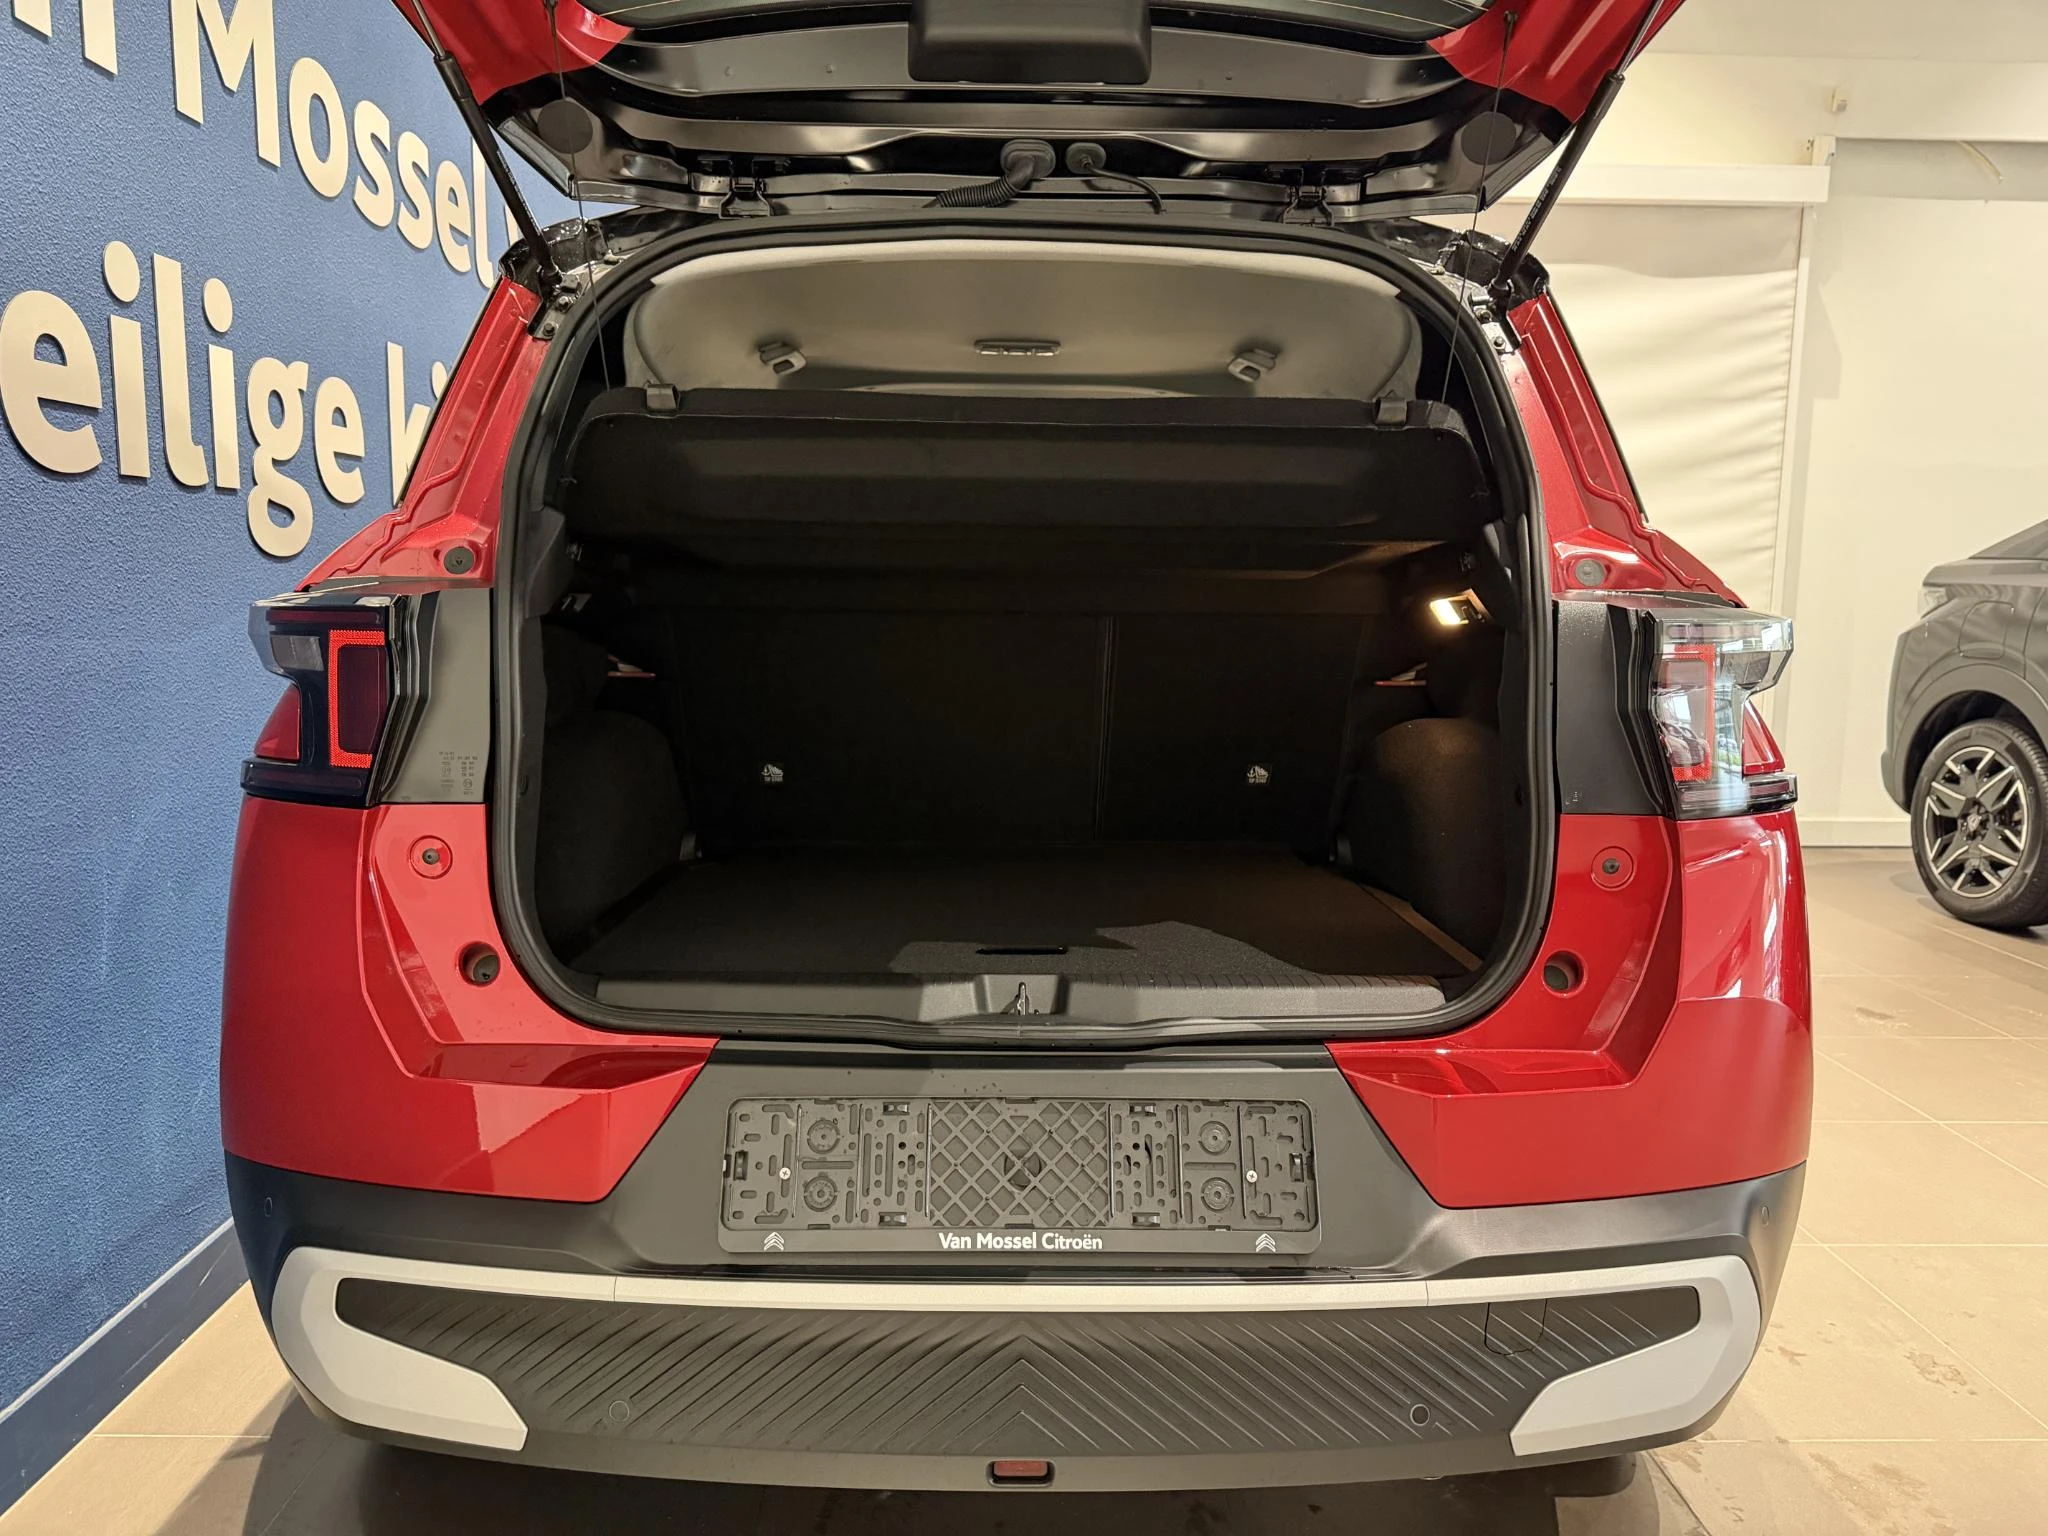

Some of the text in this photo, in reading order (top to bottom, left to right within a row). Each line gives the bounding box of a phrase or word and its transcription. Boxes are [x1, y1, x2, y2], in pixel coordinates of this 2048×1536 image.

[170, 0, 495, 289] Mossel
[0, 240, 365, 557] eilige
[938, 1231, 1103, 1249] Van Mossel Citroën
